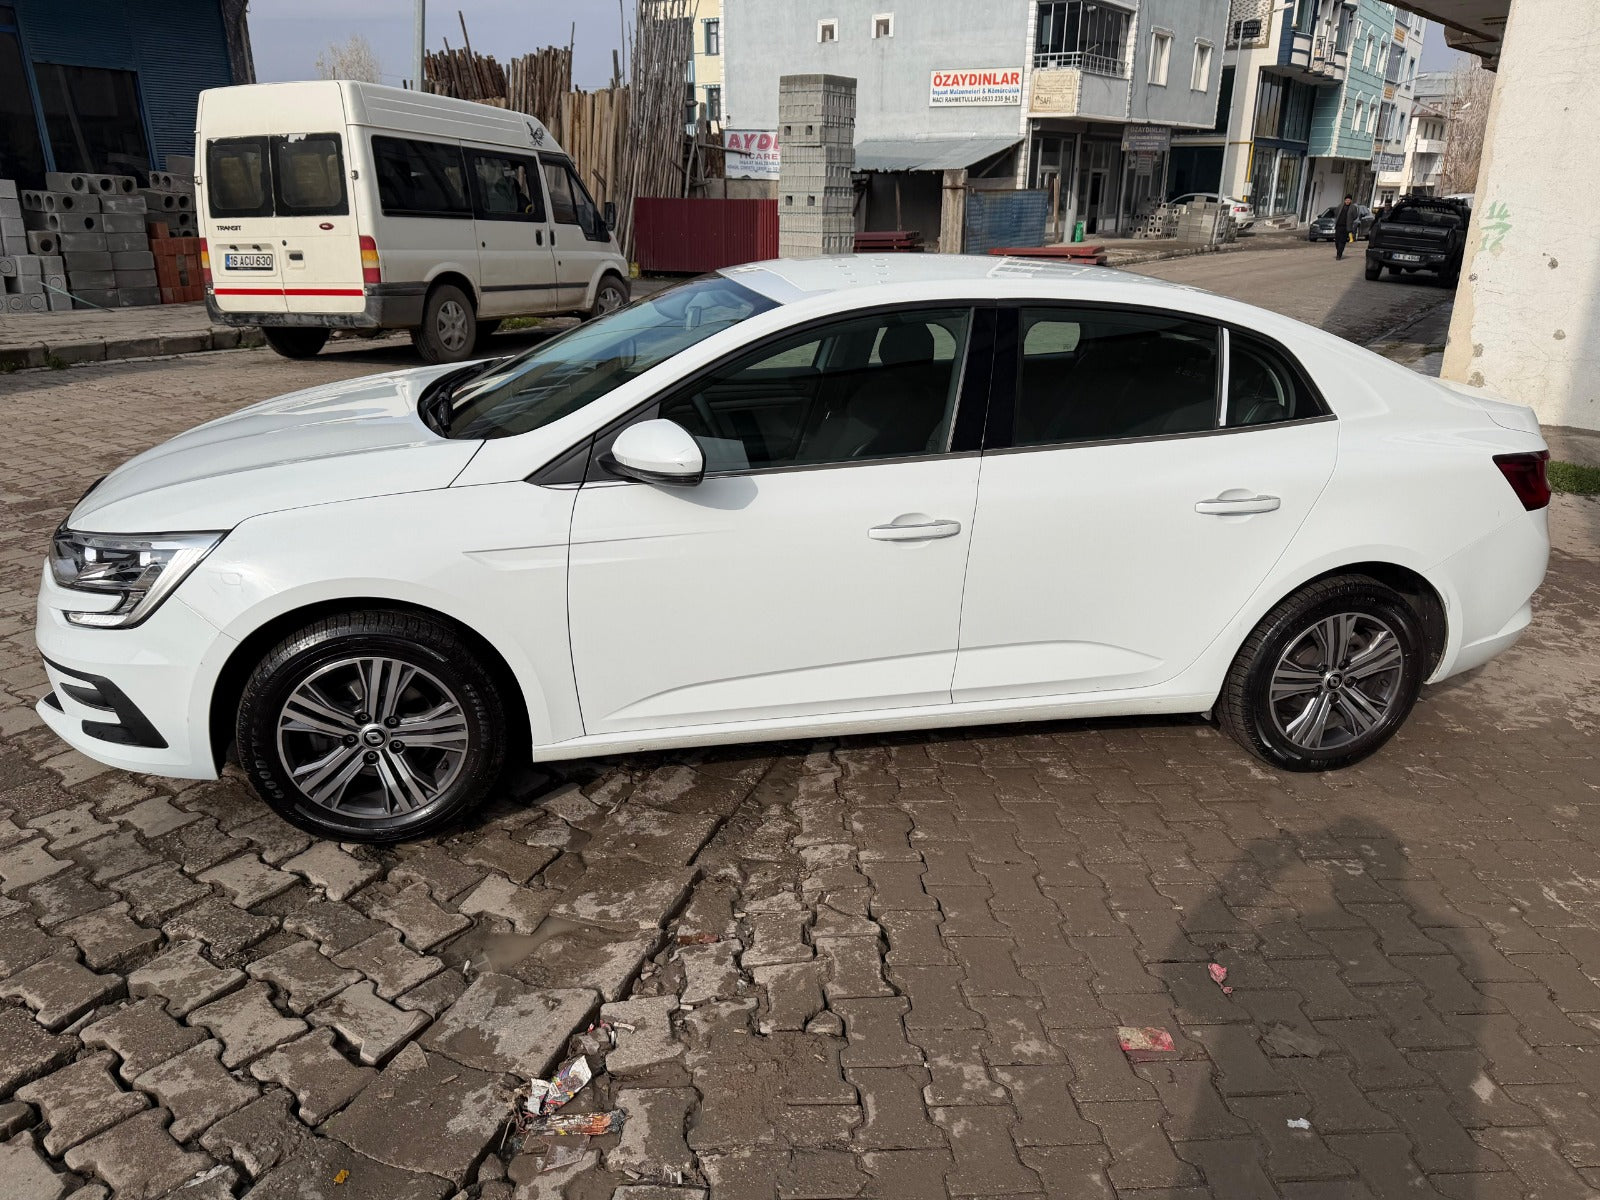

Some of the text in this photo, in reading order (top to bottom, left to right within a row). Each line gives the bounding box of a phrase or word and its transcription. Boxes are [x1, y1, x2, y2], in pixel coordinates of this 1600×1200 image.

[933, 72, 1020, 87] ÖZAYDINLAR
[230, 256, 271, 266] 16 ACU 630
